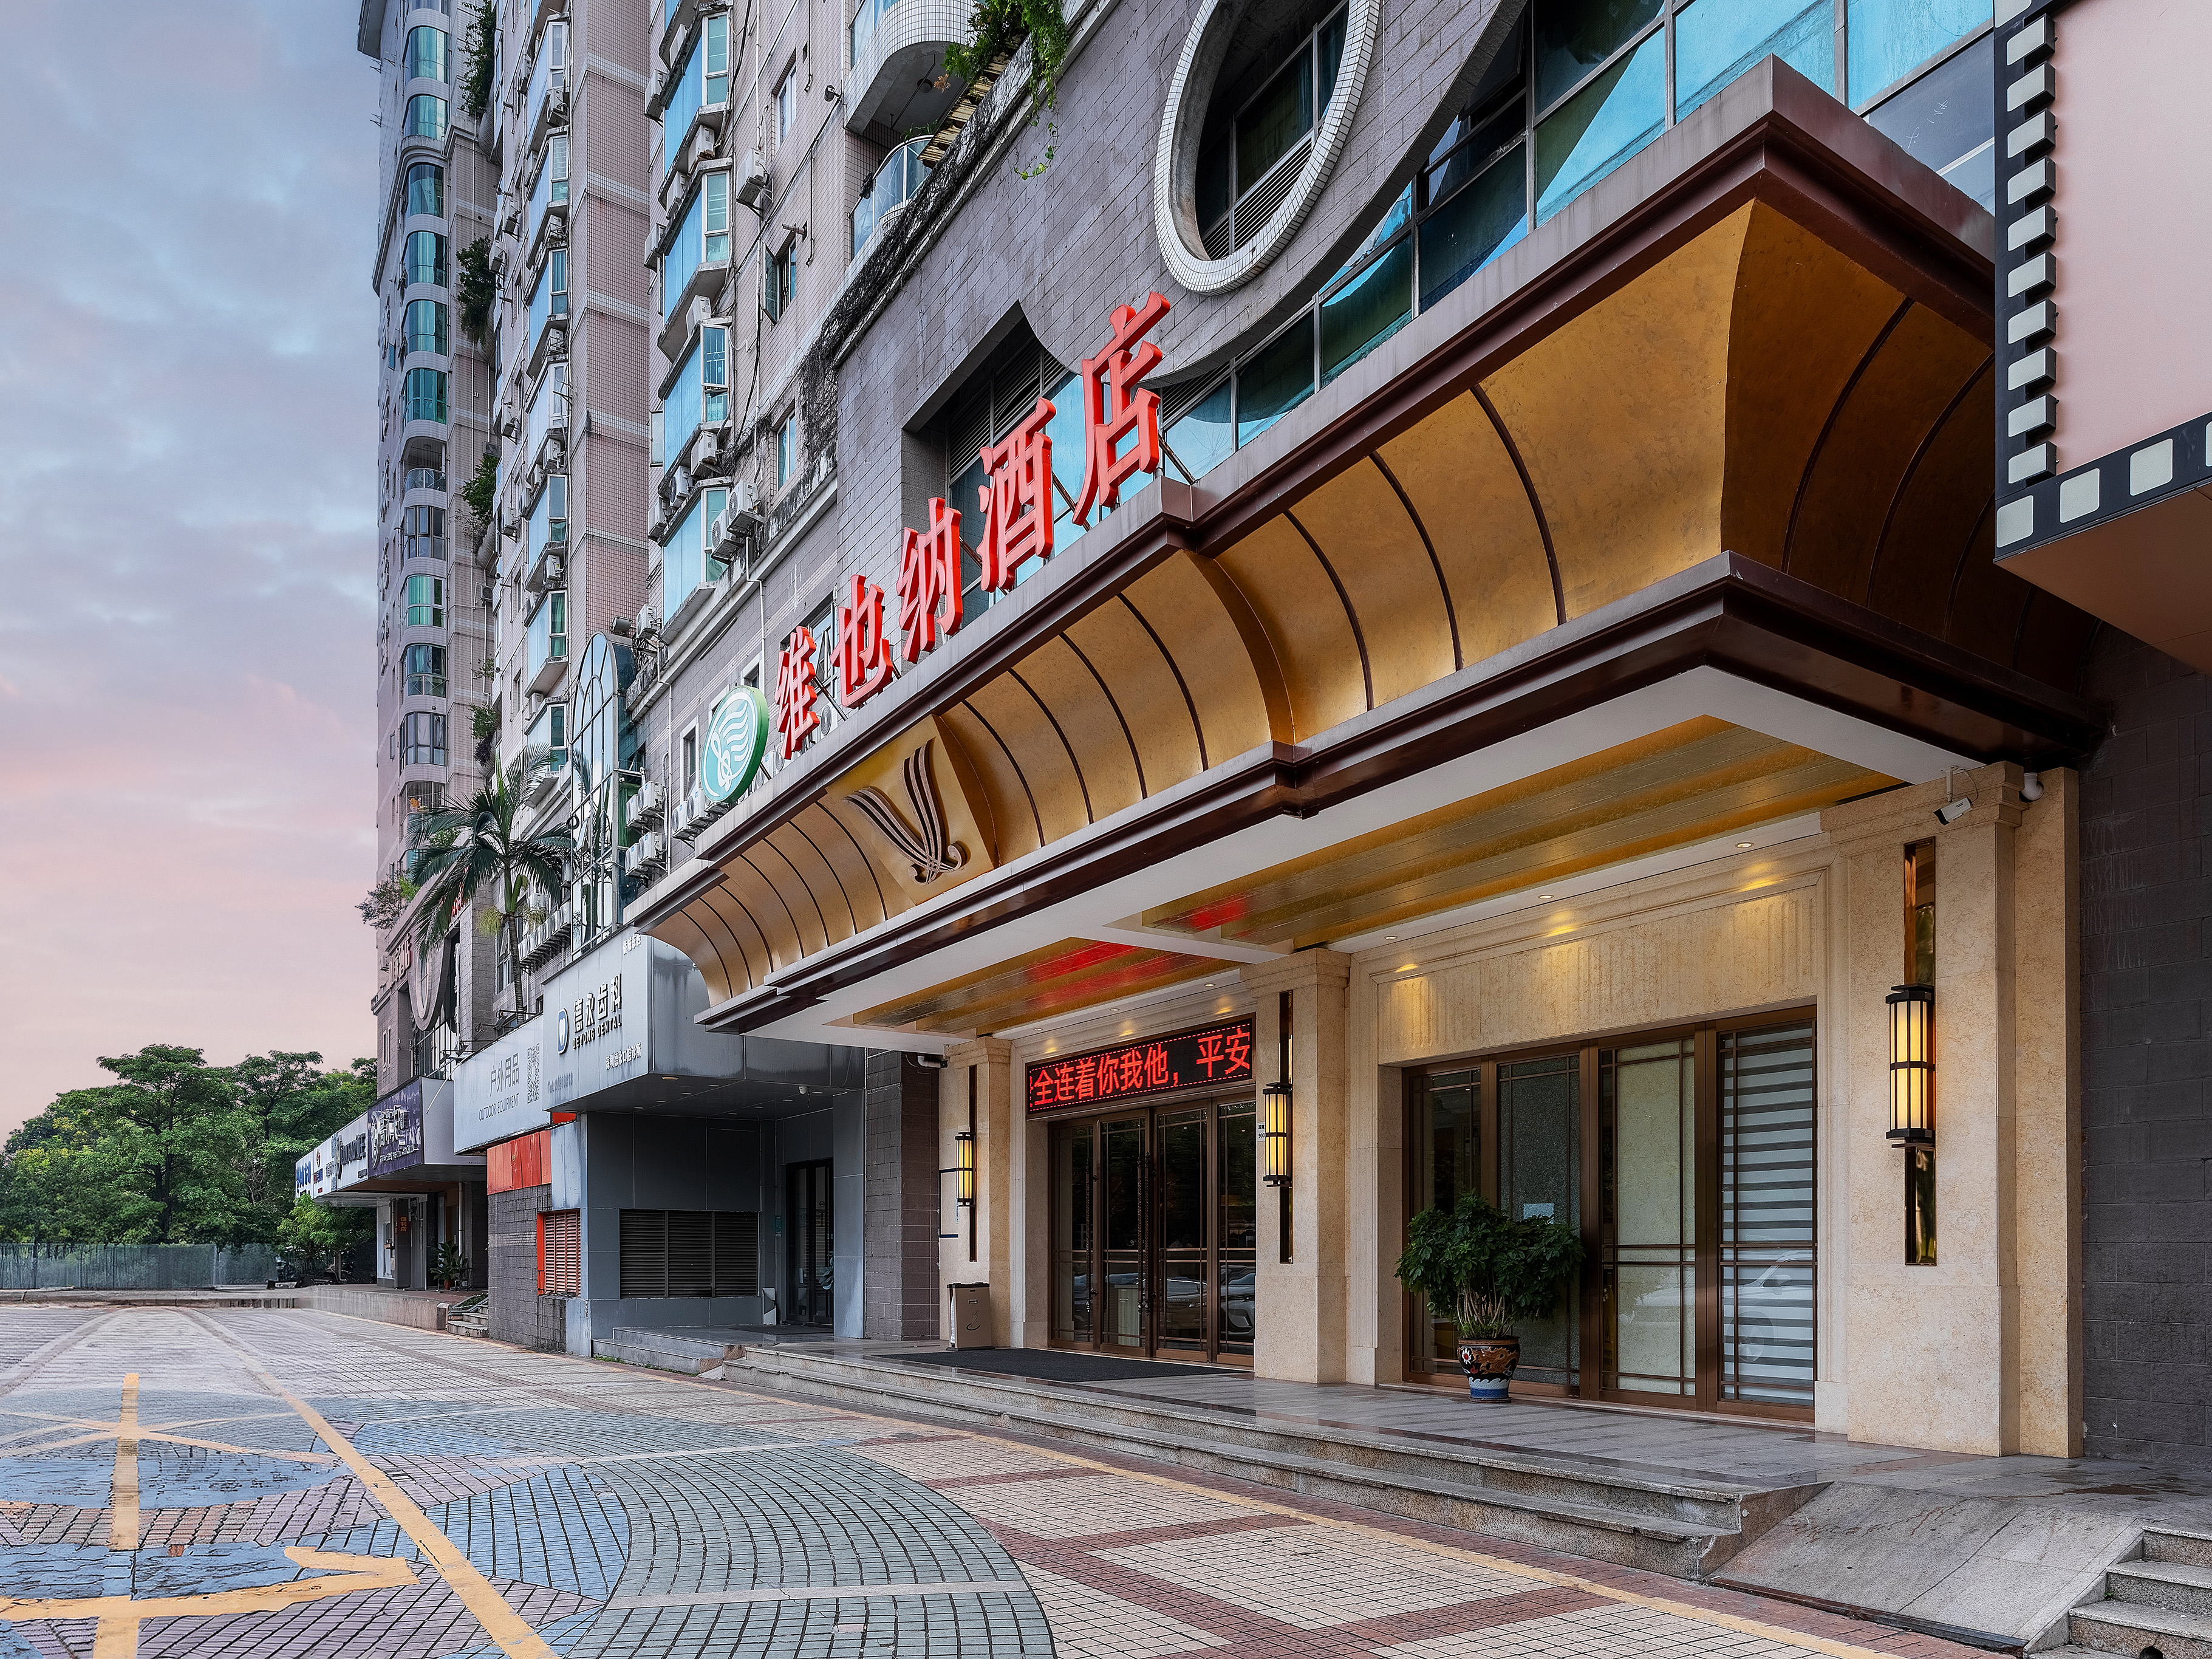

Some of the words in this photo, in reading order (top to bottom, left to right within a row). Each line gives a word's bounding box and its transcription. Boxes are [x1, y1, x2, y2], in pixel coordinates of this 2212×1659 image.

[776, 291, 1171, 759] 维也纳酒店
[573, 973, 622, 1034] 德永齿科
[573, 1028, 595, 1050] DEYONG
[597, 1014, 622, 1038] DENTAL
[490, 1053, 519, 1097] 户外用品
[606, 1042, 642, 1070] 深圳德永口腔诊所
[479, 1103, 496, 1121] OUTDOOR
[497, 1093, 519, 1113] EQUIPMENT
